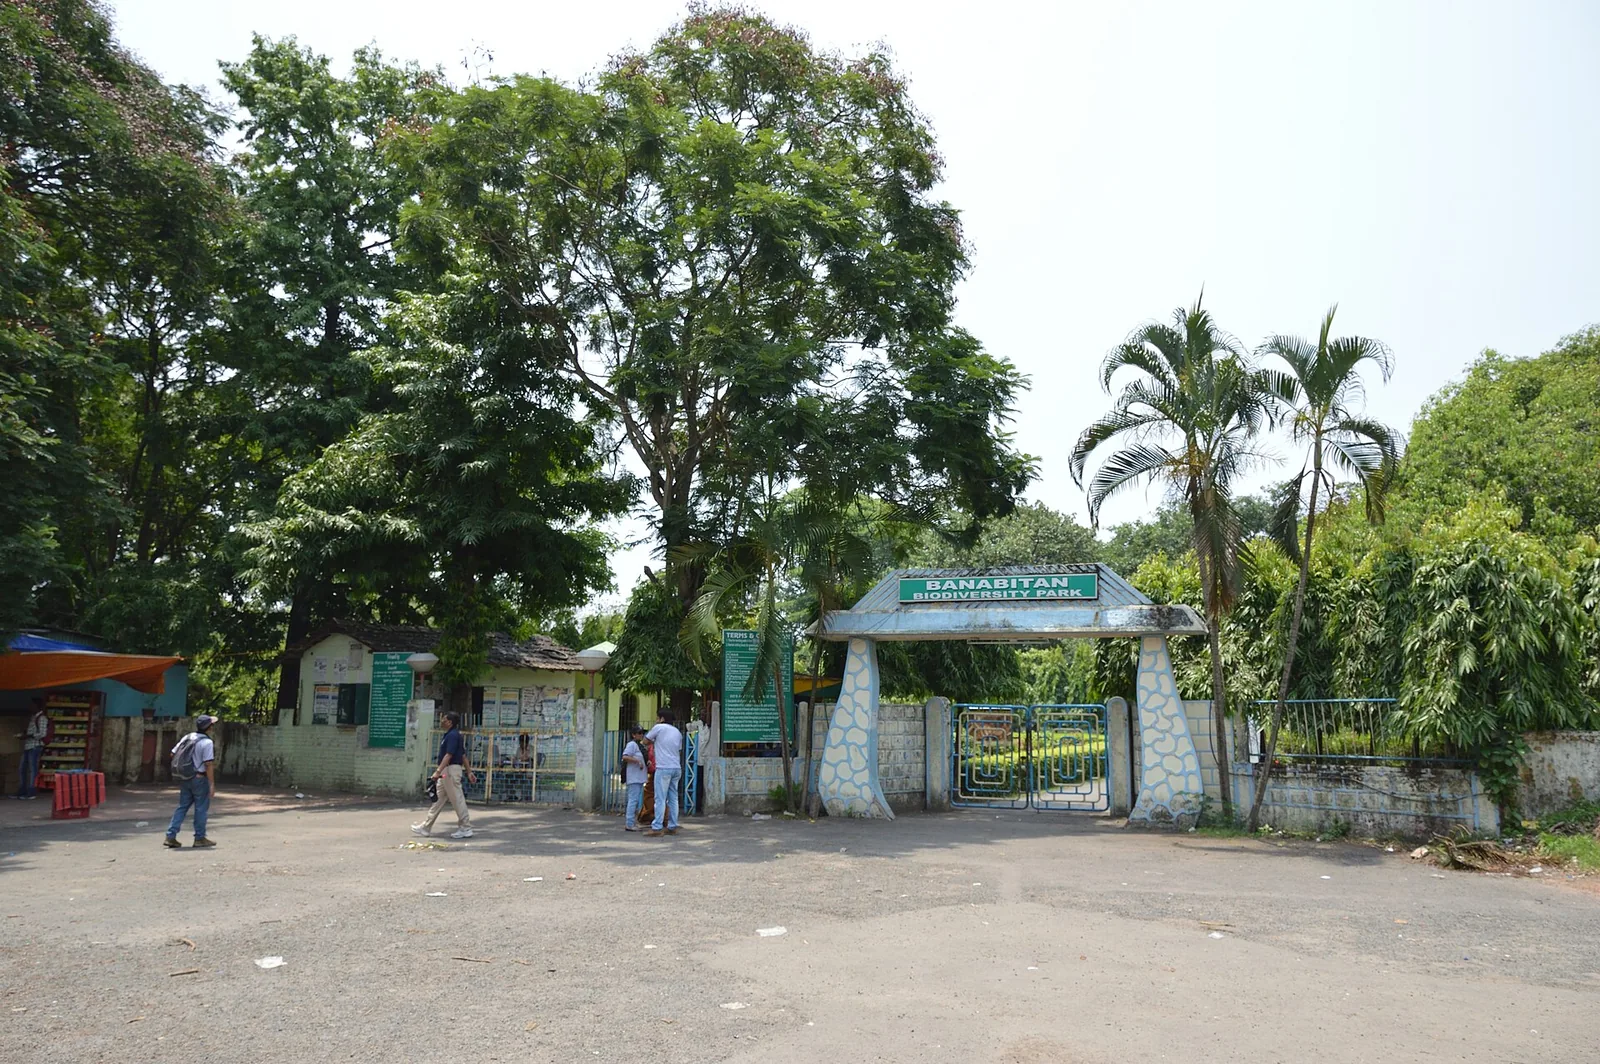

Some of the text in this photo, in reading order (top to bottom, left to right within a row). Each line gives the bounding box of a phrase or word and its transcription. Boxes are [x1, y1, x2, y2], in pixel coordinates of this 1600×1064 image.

[926, 577, 1068, 591] BANABITAN
[913, 589, 1082, 600] BIODIVERSITY PARK
